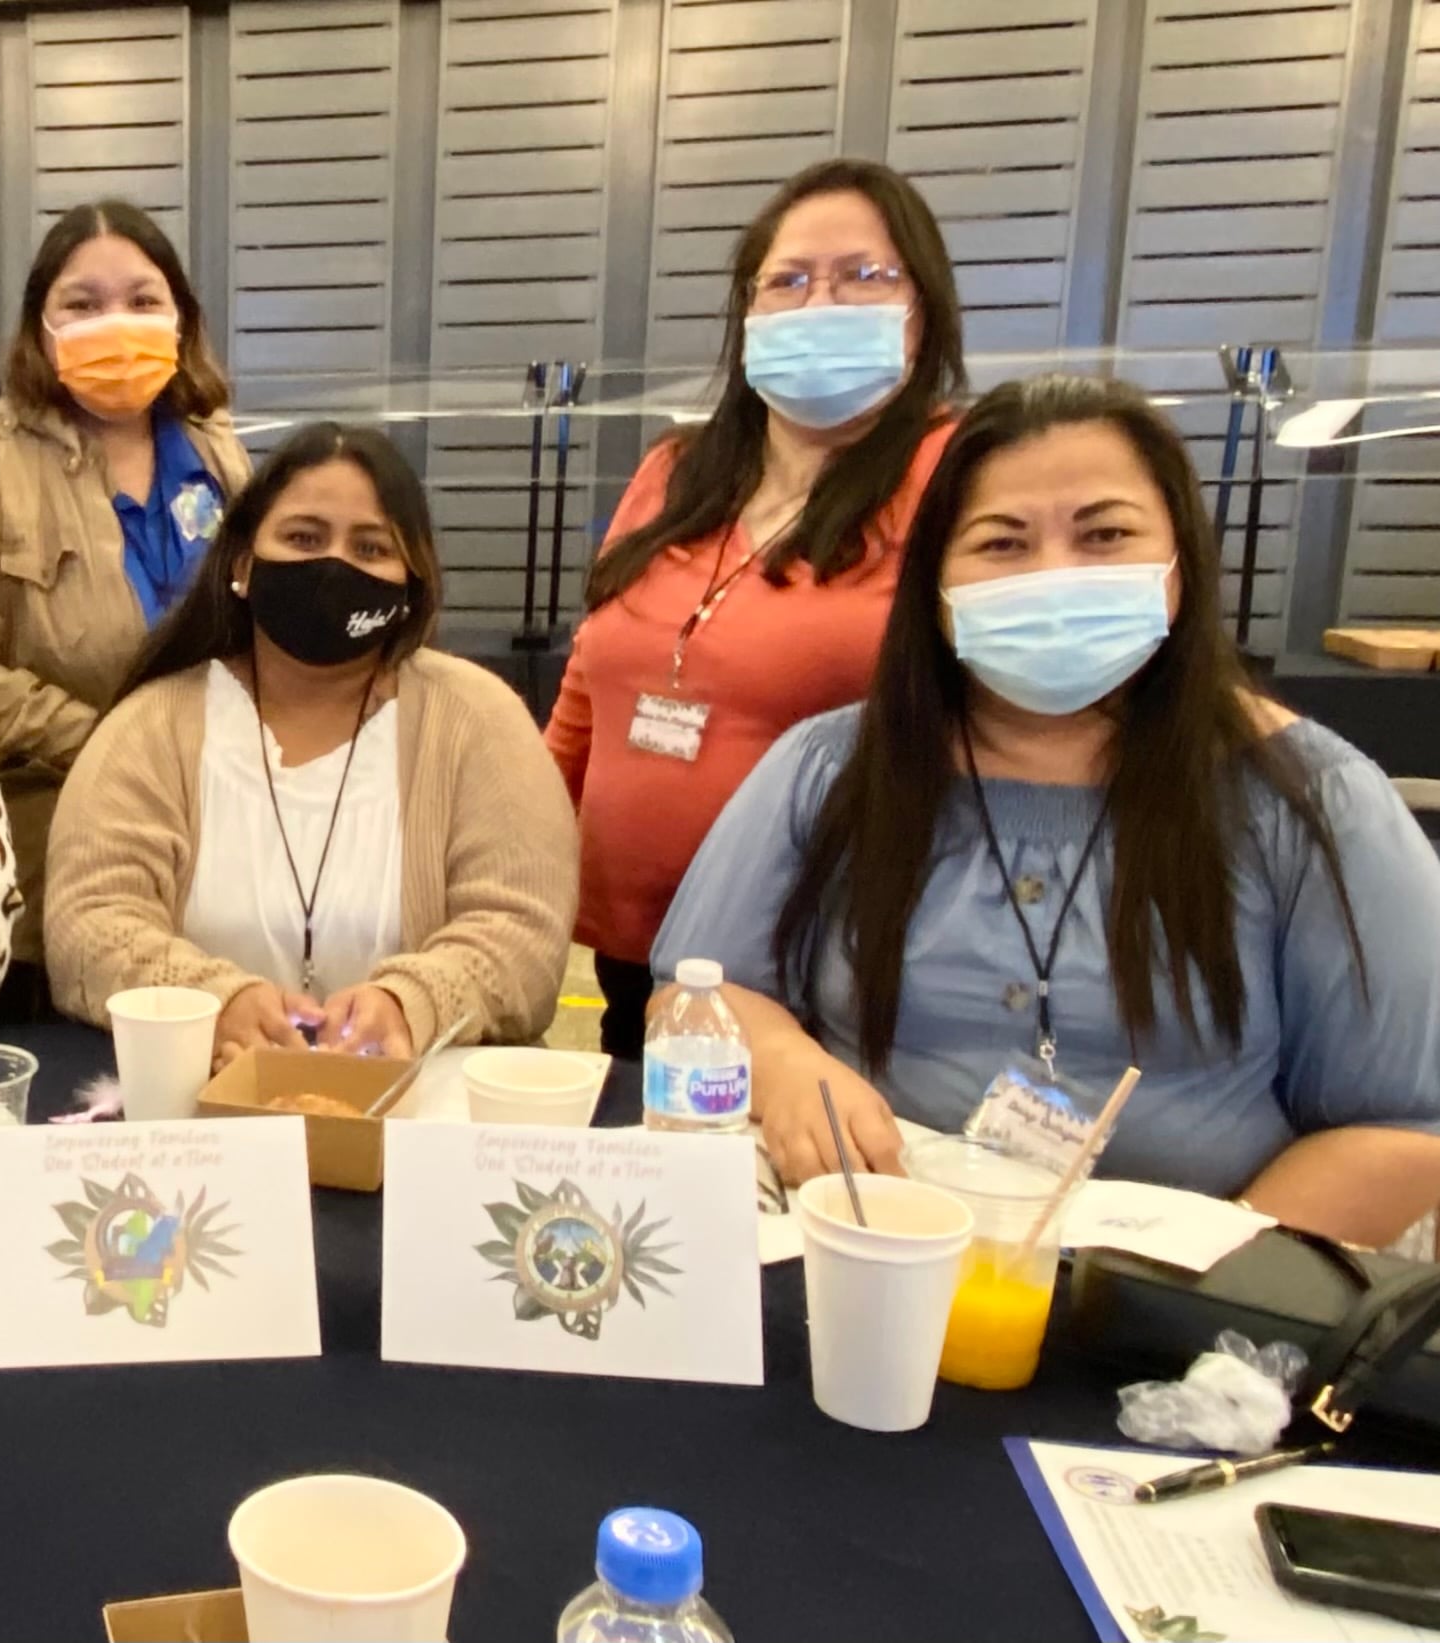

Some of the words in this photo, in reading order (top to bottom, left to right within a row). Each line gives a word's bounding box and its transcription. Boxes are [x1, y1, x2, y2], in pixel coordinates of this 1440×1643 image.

[691, 1080, 725, 1096] Pure
[475, 1130, 576, 1156] Empowering
[587, 1138, 661, 1157] Families
[44, 1155, 72, 1172] One
[81, 1152, 145, 1171] Student
[151, 1152, 166, 1169] at
[475, 1153, 505, 1171] One
[514, 1155, 580, 1176] Student
[587, 1160, 604, 1178] at
